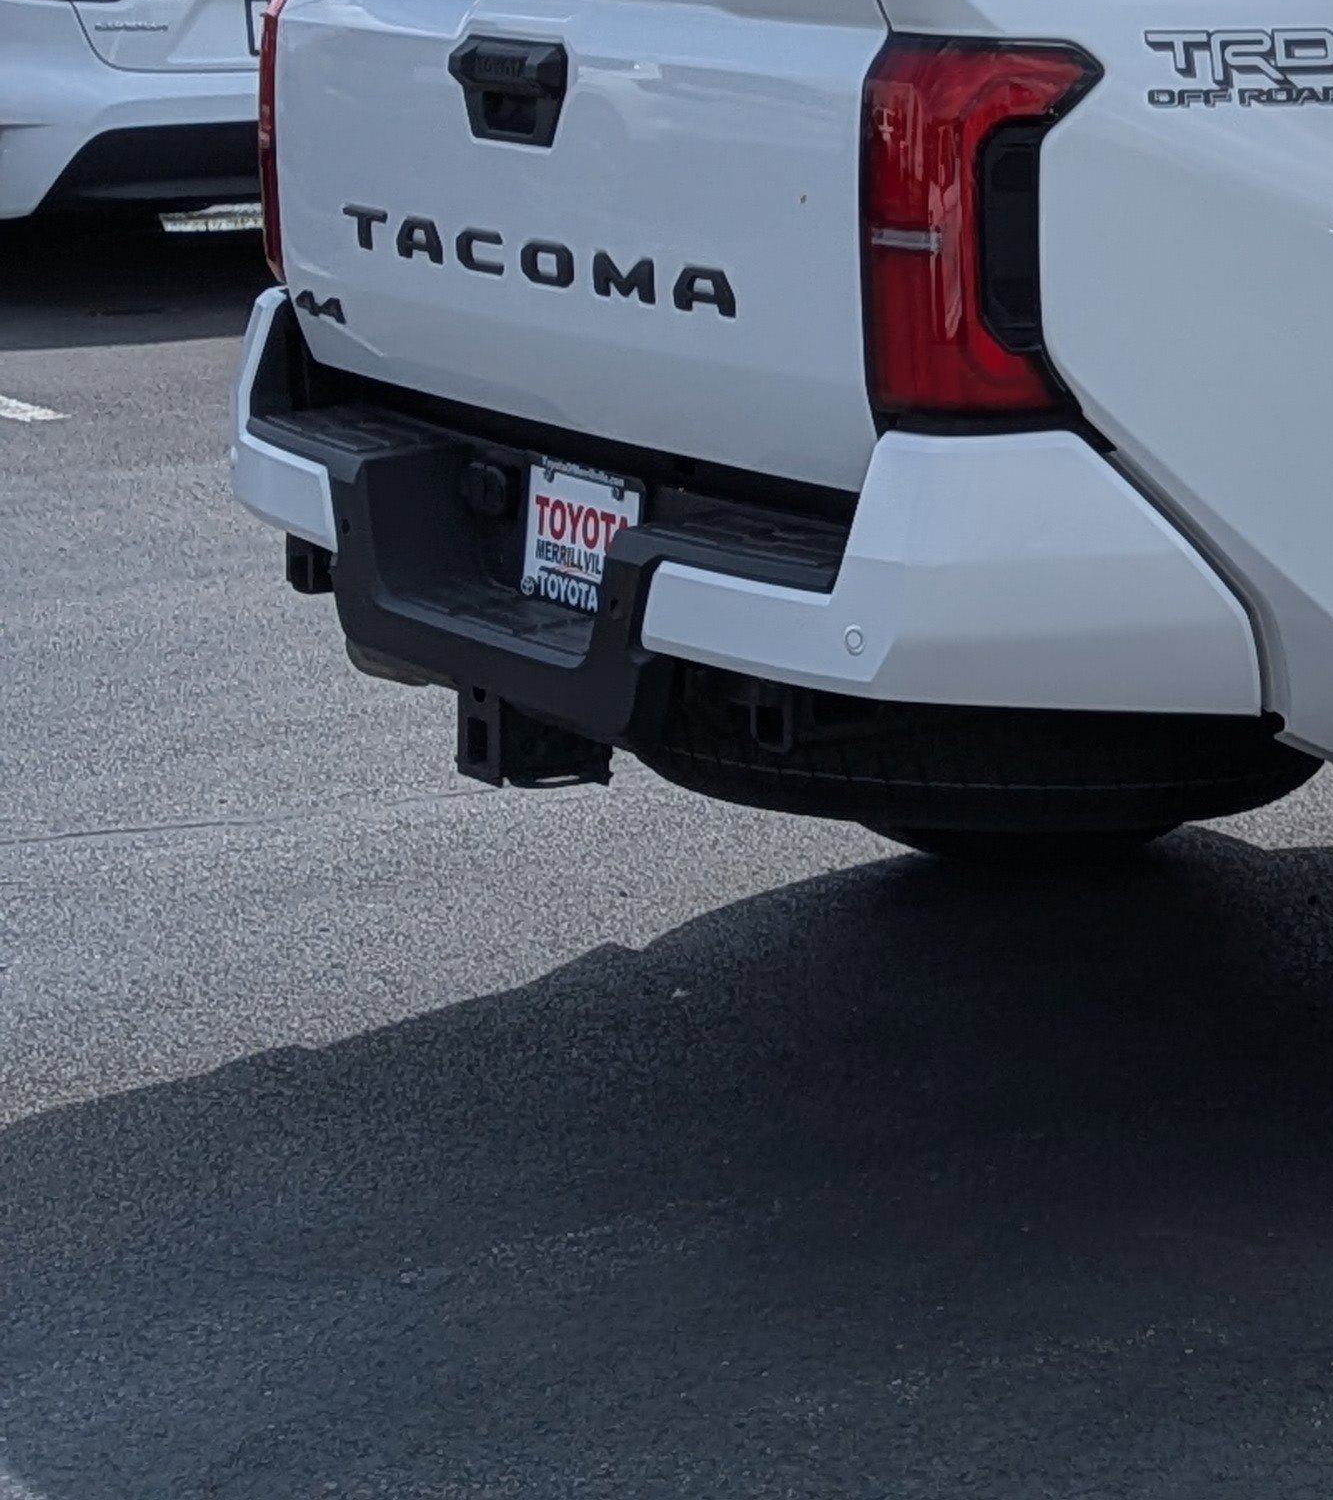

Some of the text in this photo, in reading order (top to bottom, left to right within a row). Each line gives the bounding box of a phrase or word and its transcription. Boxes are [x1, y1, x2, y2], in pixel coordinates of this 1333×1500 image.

[1147, 88, 1233, 108] OFF
[342, 202, 737, 319] TACOMA
[535, 494, 628, 553] TOYOT
[536, 538, 601, 575] MERRILLVIL
[538, 571, 599, 613] TOYOTA
